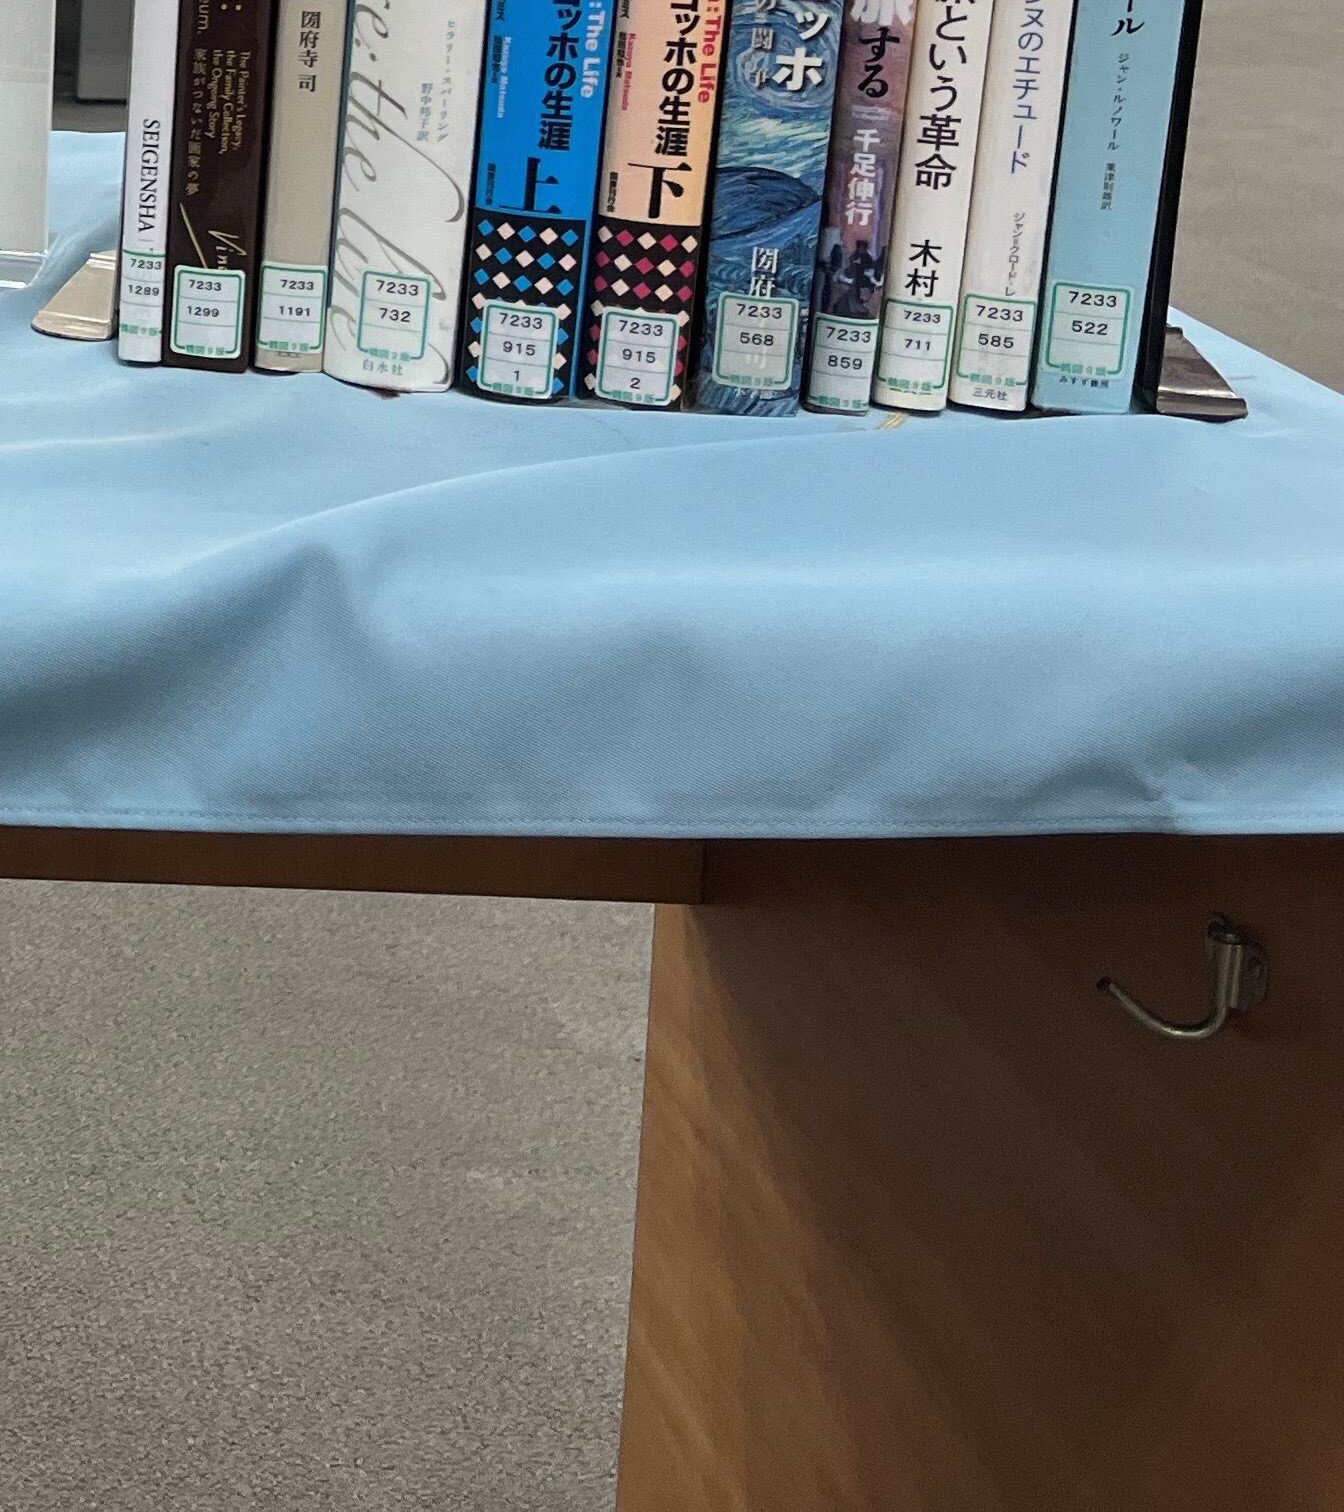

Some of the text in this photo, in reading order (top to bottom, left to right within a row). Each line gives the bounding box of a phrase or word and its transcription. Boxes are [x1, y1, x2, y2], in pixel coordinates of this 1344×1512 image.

[585, 14, 606, 52] The
[703, 14, 725, 57] The
[580, 56, 601, 99] Life
[697, 61, 718, 104] Life
[137, 118, 161, 234] SEIGENSHA
[844, 128, 881, 227] 千足伸行
[498, 156, 562, 214] 上
[627, 162, 693, 220] 下
[129, 258, 162, 270] 7233
[904, 238, 943, 298] 木村
[187, 278, 223, 292] 7233
[279, 278, 315, 292] 7233
[374, 279, 419, 296] 7233
[1068, 290, 1118, 308] 7233
[186, 305, 221, 318] 1299
[278, 304, 311, 318] 1191
[379, 306, 412, 323] 732
[736, 303, 783, 320] 7233
[903, 309, 942, 324] 7233
[975, 304, 1024, 323] 7233
[498, 312, 543, 330] 7233
[618, 320, 664, 337] 7233
[1071, 319, 1109, 336] 522
[739, 331, 775, 347] 568
[826, 326, 873, 344] 7233
[978, 333, 1014, 350] 585
[502, 341, 537, 356] 915
[904, 338, 932, 351] 711
[621, 348, 657, 364] 915
[827, 354, 864, 371] 859
[971, 387, 1008, 401] 三元社
